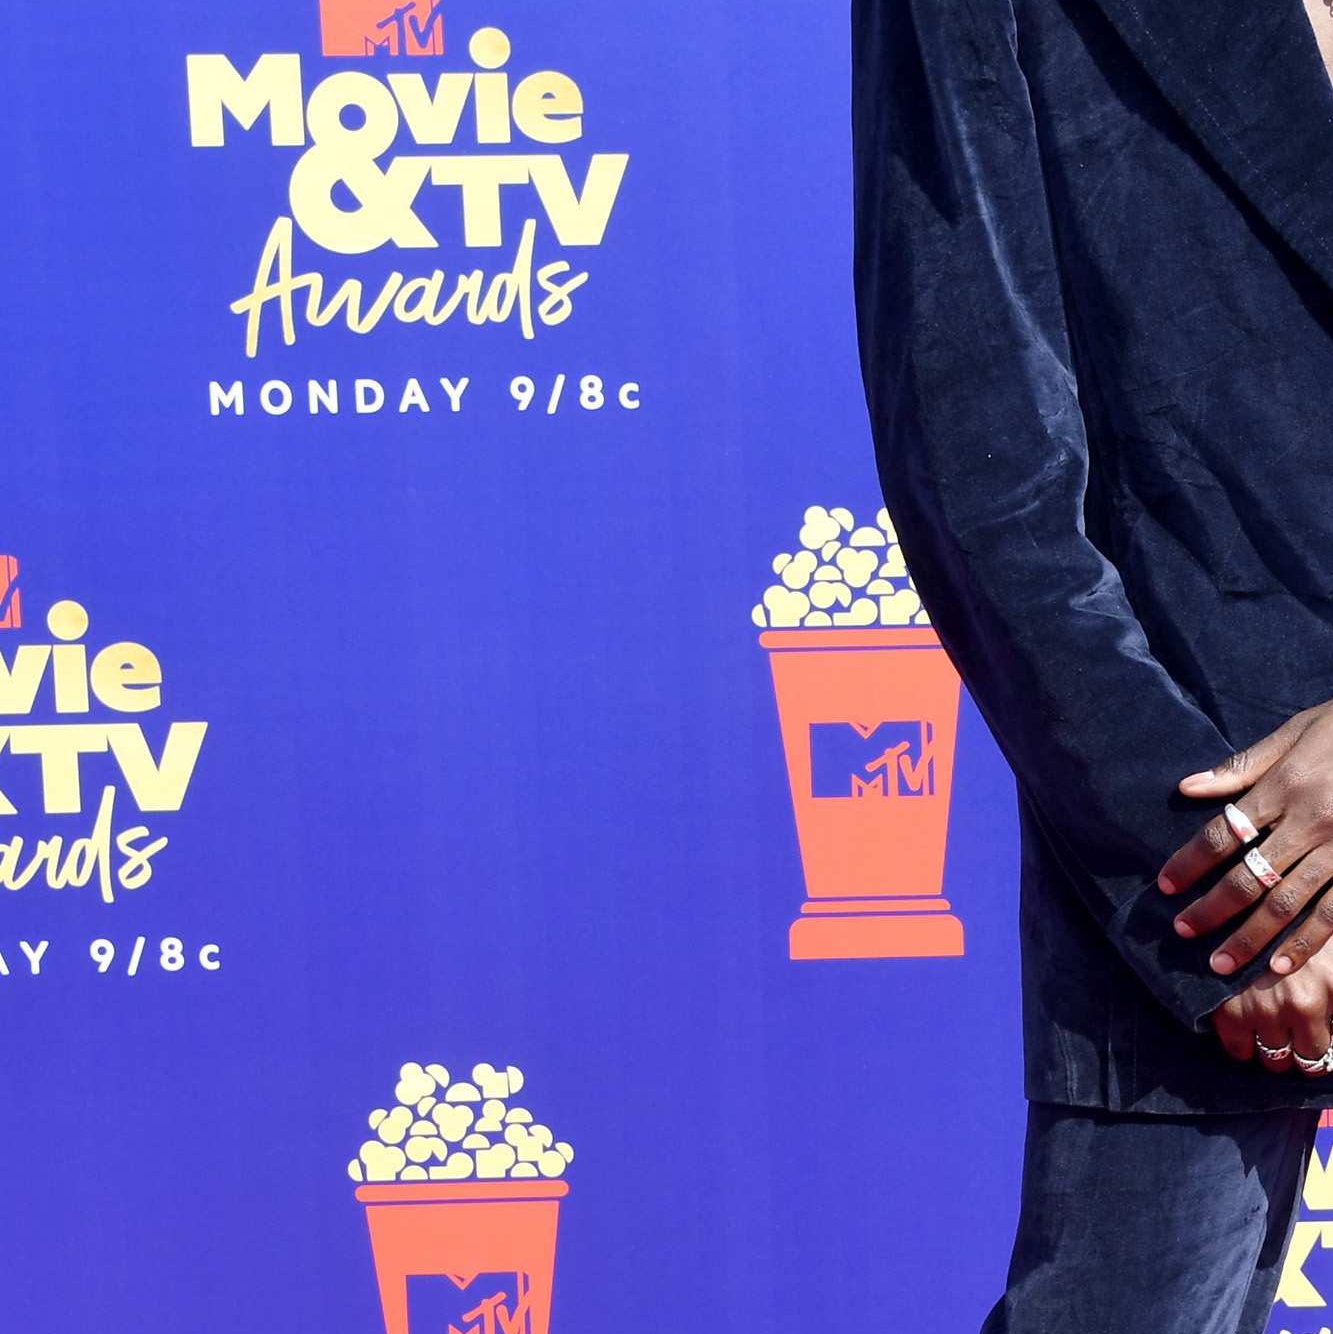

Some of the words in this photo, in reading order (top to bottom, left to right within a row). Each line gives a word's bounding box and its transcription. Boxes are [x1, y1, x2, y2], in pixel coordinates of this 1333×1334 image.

[186, 27, 584, 147] Movie
[230, 216, 588, 358] Awards
[209, 377, 469, 415] MONDAY
[509, 374, 640, 414] 9/8c
[0, 721, 208, 815] TV
[808, 720, 935, 798] MTV
[90, 936, 221, 975] 9/8c
